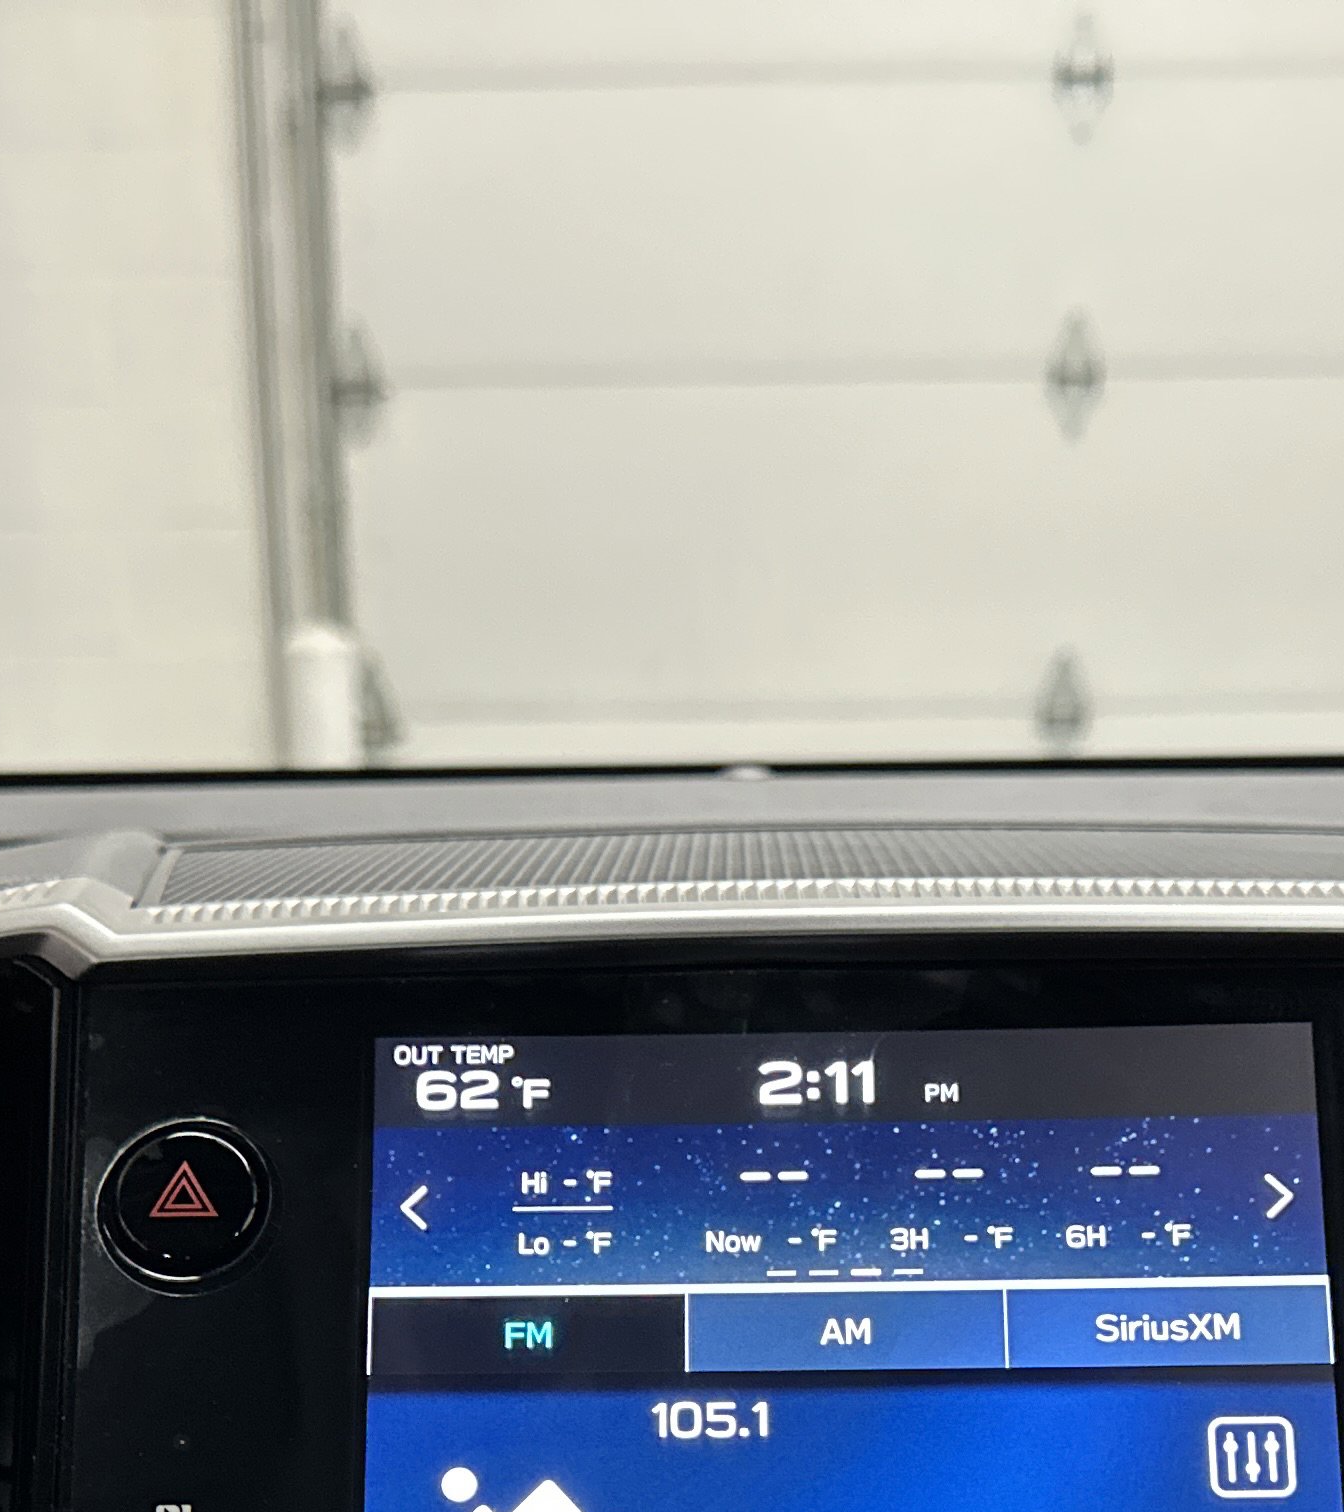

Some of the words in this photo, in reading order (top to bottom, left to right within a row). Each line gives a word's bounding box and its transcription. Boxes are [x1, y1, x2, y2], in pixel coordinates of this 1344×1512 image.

[394, 1045, 443, 1065] OUT
[451, 1045, 514, 1065] TEMP
[416, 1070, 500, 1111] 62
[758, 1058, 875, 1106] 2:11
[924, 1082, 959, 1103] PM
[521, 1171, 548, 1194] Hi
[518, 1233, 550, 1255] Lo
[706, 1230, 761, 1253] Now
[890, 1228, 930, 1250] 3H
[1065, 1225, 1107, 1247] 6H
[504, 1321, 553, 1350] FM
[819, 1317, 872, 1346] AM
[1095, 1312, 1241, 1343] SiriusXM
[651, 1400, 769, 1439] 105.1
